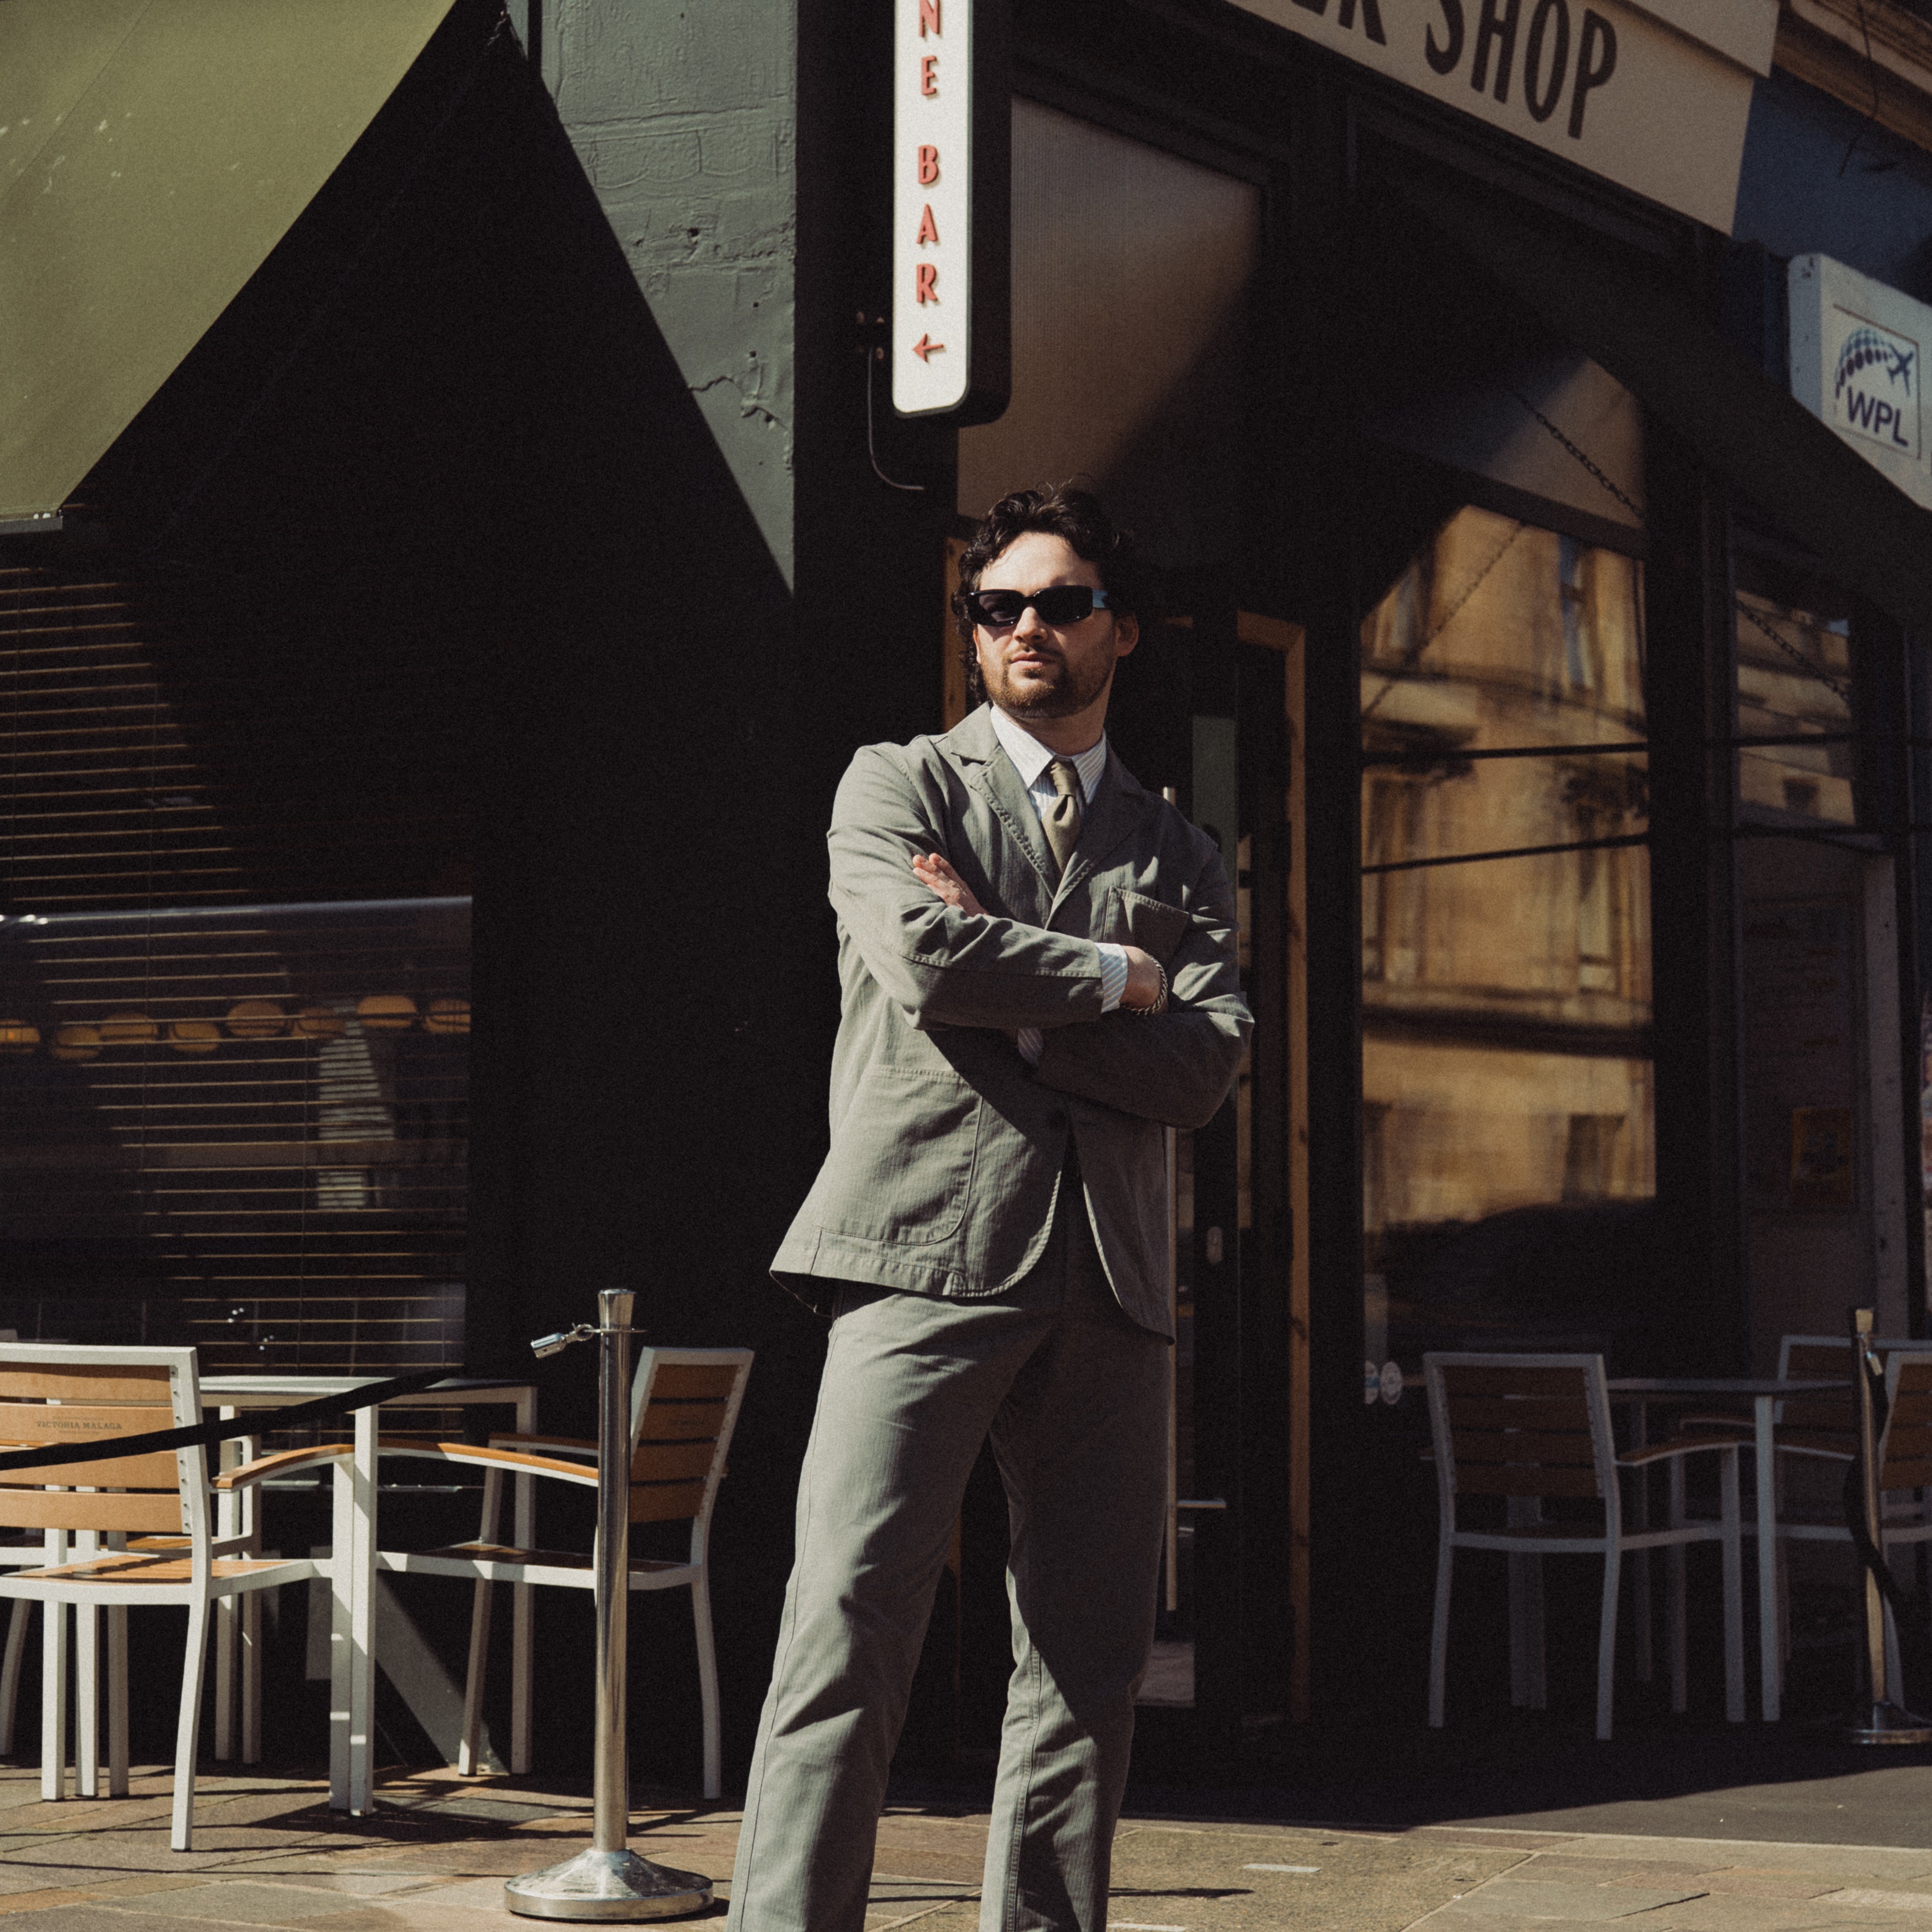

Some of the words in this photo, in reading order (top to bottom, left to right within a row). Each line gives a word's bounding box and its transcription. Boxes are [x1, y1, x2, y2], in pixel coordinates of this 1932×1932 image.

[1425, 0, 1618, 139] SHOP
[916, 145, 939, 303] BAR
[1847, 386, 1908, 446] WPL
[36, 1421, 80, 1429] VICTORIA
